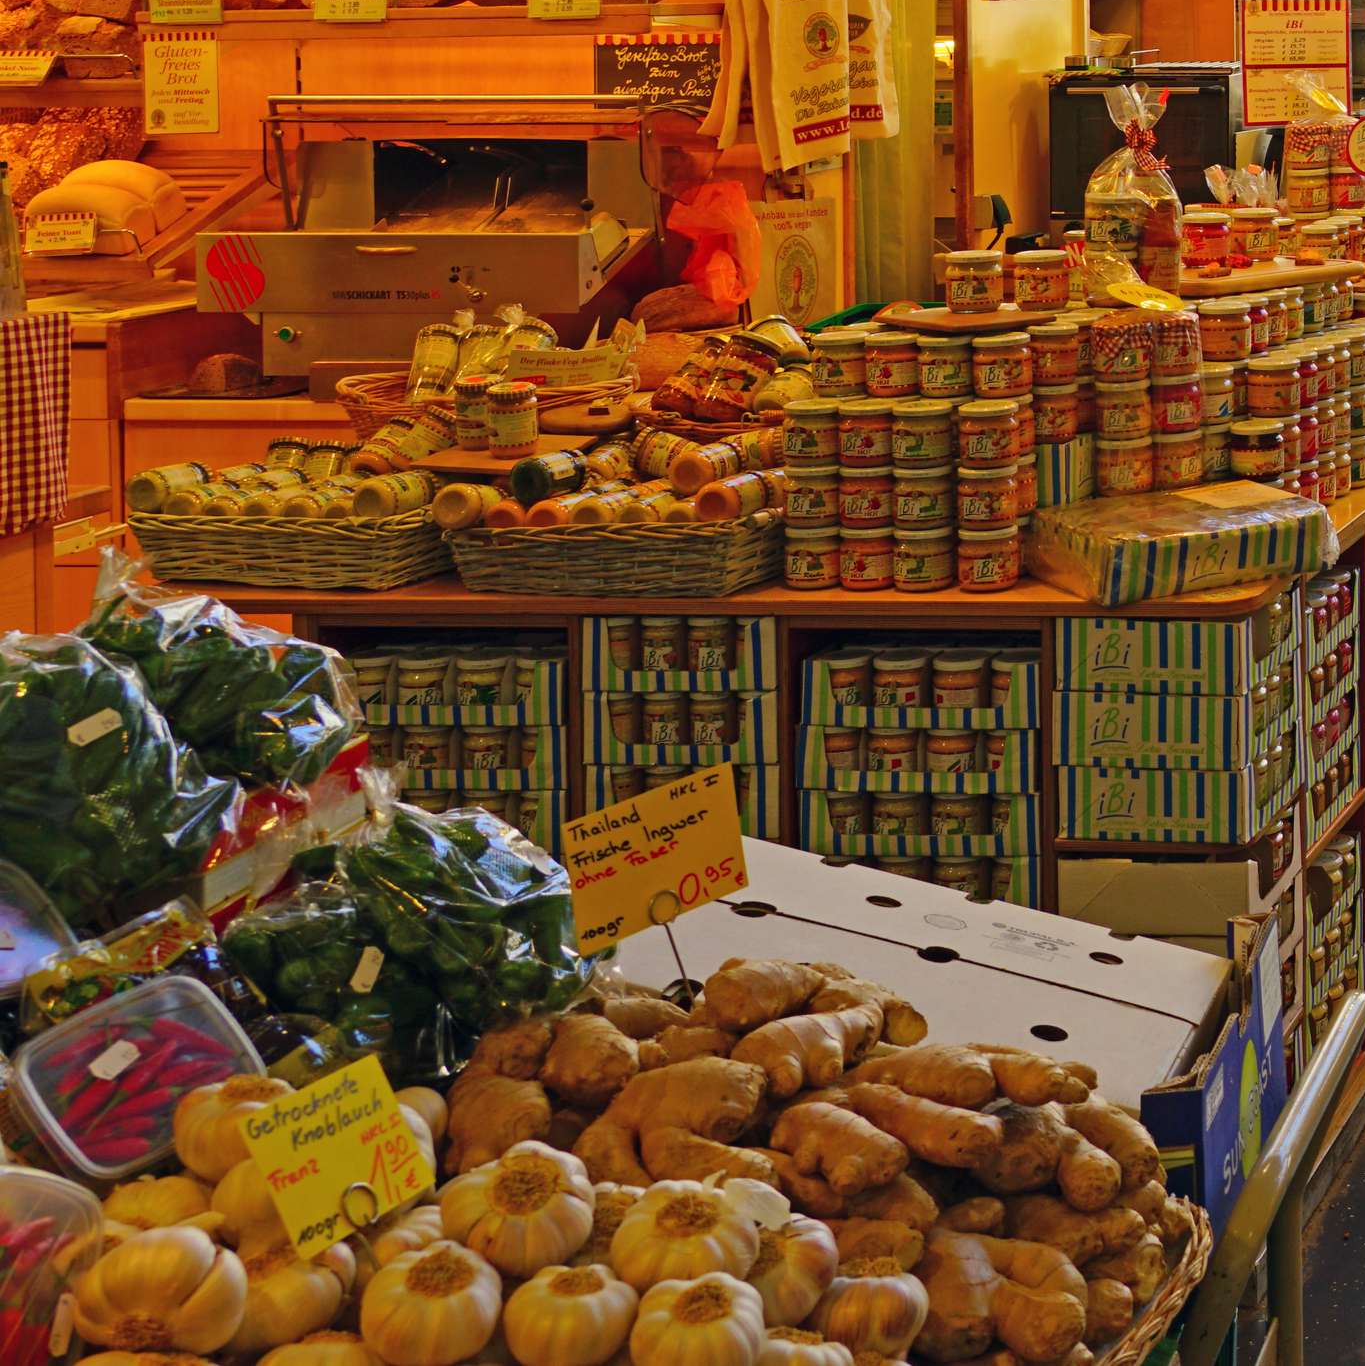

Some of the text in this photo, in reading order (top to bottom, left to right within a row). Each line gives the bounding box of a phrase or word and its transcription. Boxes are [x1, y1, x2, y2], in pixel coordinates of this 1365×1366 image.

[1285, 19, 1304, 30] iBi
[154, 45, 208, 59] Gluten-
[160, 58, 200, 74] freies
[670, 45, 709, 62] Brot
[167, 72, 198, 84] Brot
[679, 78, 712, 97] Preis
[1192, 543, 1229, 577] iBi
[1095, 633, 1131, 667] iBi
[1094, 706, 1130, 740] iBi
[1099, 781, 1135, 815] iBi
[568, 802, 641, 842] Thailand
[571, 810, 709, 868] Frische Ingwer
[575, 841, 679, 890] ohne Faser
[246, 1072, 359, 1140] Getrocknete
[291, 1088, 383, 1152] Knoblauch
